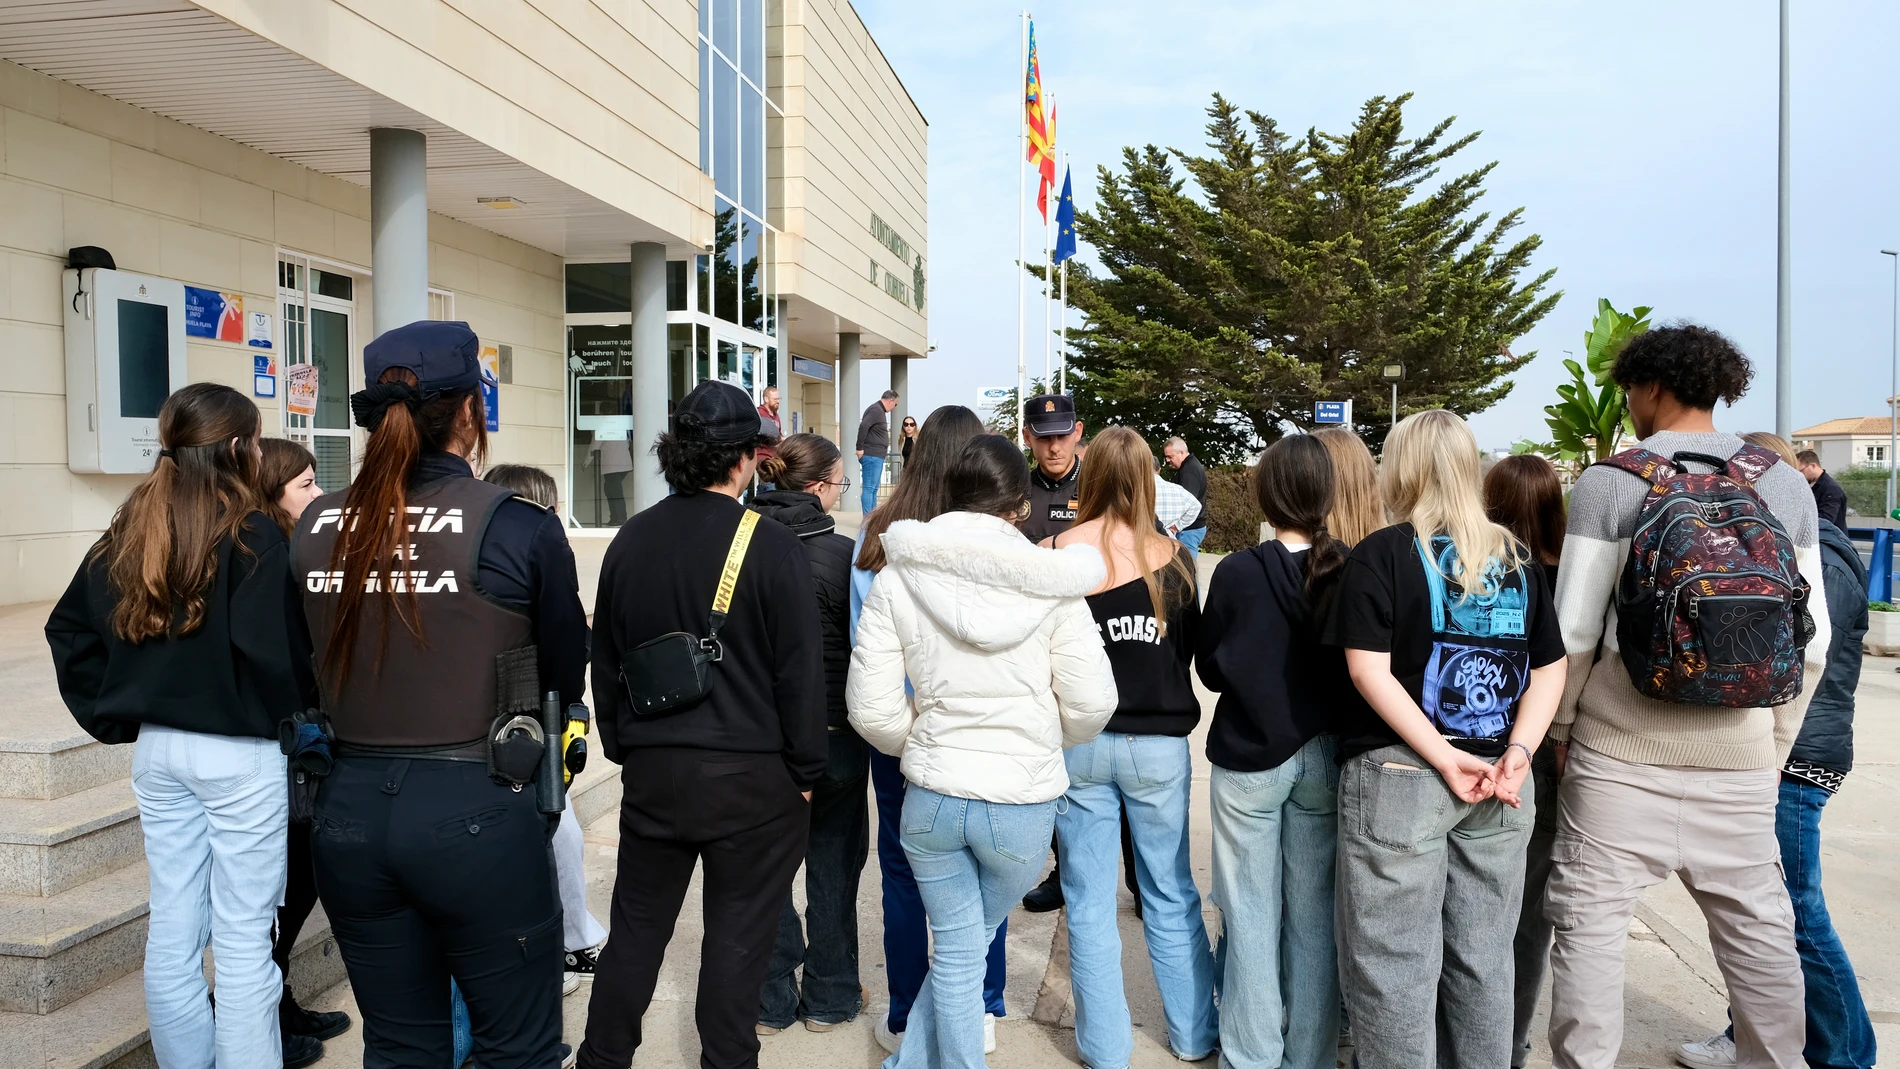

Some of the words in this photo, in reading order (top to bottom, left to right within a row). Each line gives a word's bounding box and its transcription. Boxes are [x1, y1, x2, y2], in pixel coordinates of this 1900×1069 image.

[186, 304, 205, 313] TOURIST
[199, 321, 212, 329] PLAYA
[1050, 510, 1078, 519] POLICI
[311, 506, 463, 534] POCIA
[715, 560, 740, 613] WHITE
